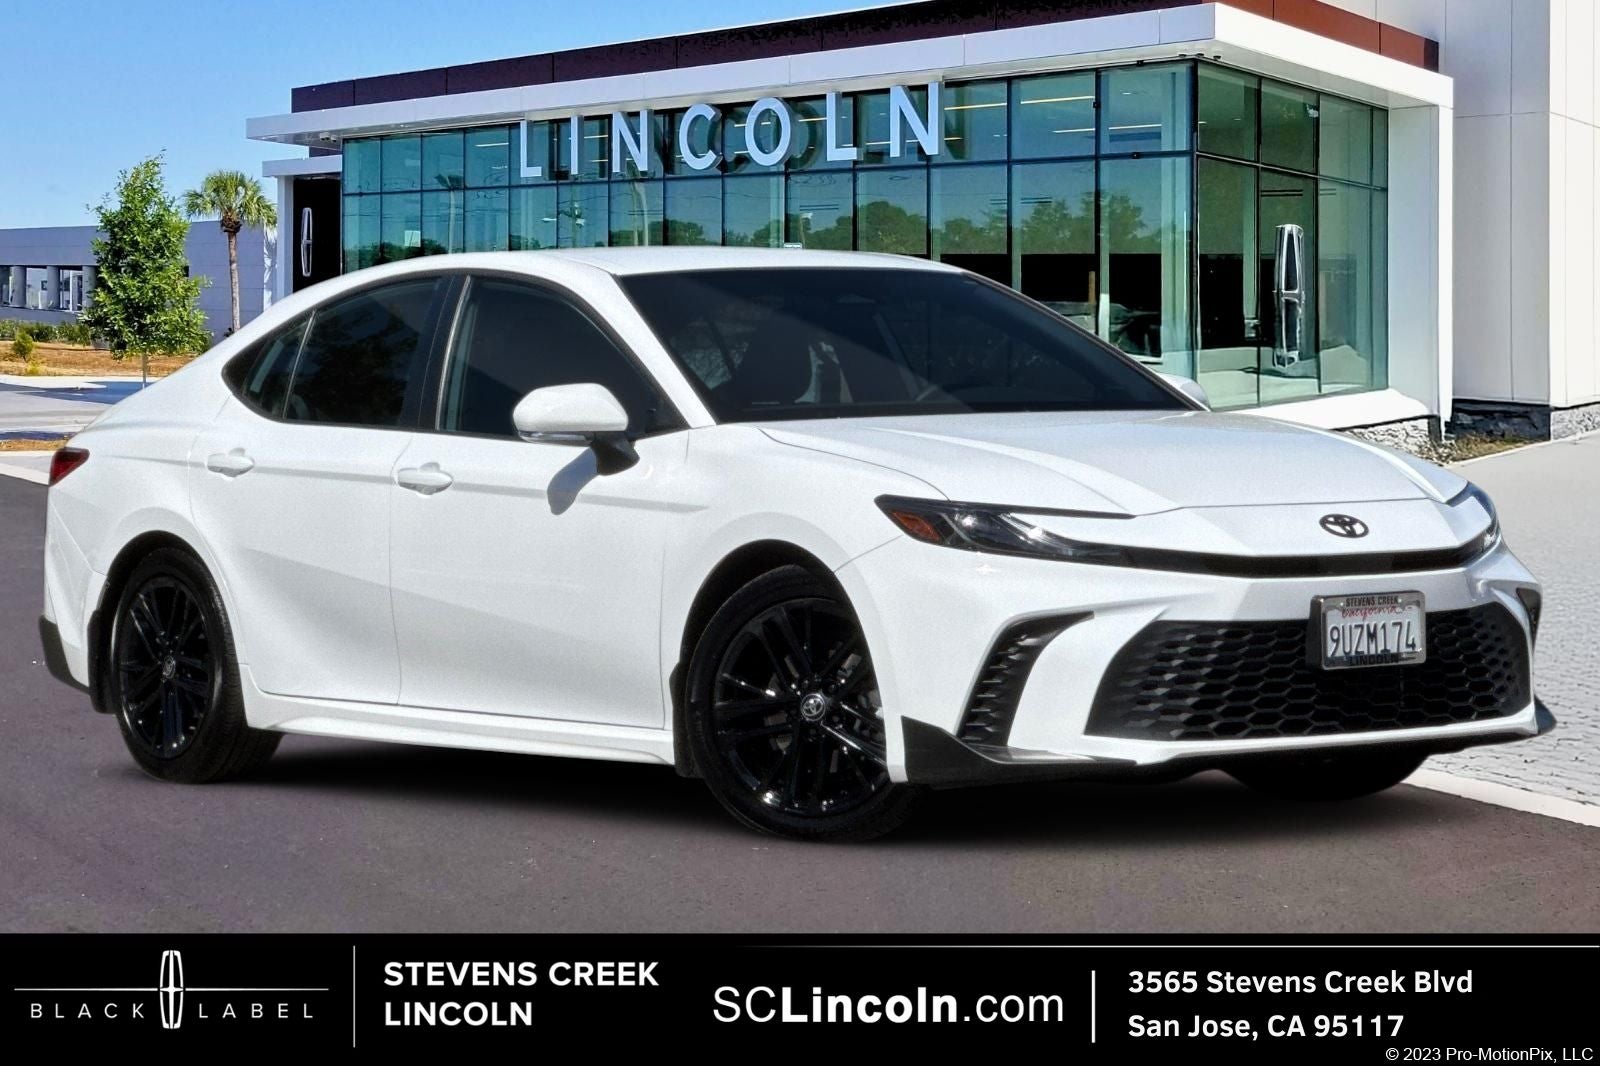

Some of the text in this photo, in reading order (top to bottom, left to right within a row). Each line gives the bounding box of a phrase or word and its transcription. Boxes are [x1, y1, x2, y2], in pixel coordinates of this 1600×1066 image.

[520, 81, 944, 178] LINCOLN
[1345, 595, 1399, 607] STEVENS CREEK
[1329, 621, 1416, 657] 9UZM174
